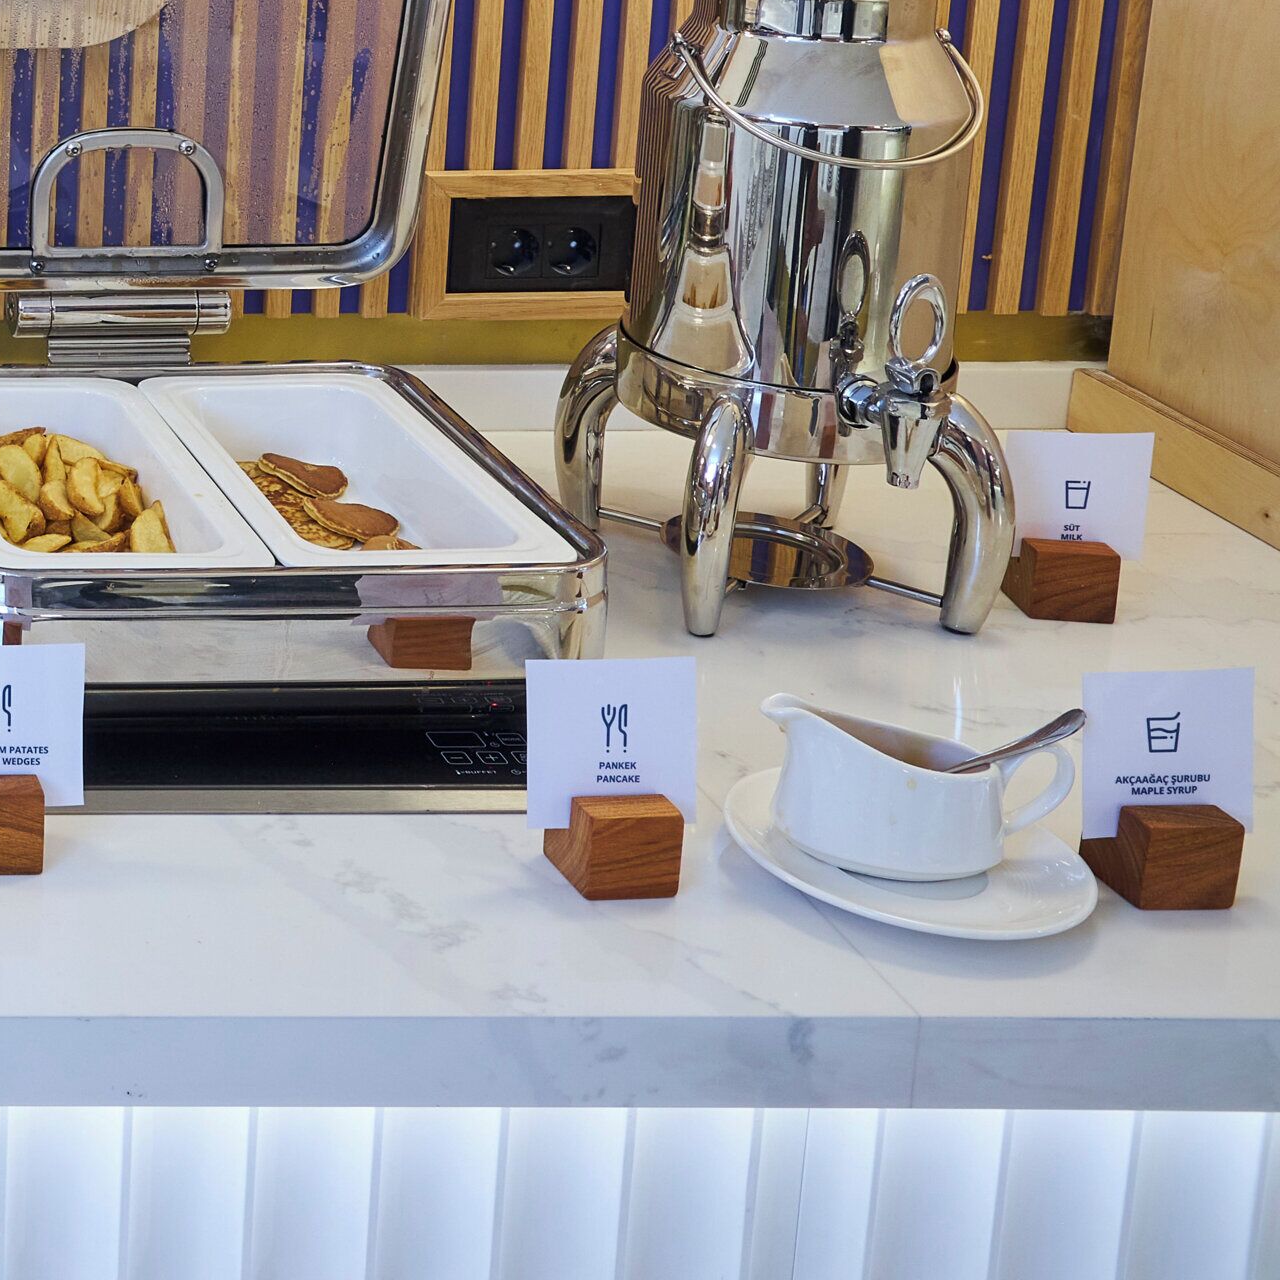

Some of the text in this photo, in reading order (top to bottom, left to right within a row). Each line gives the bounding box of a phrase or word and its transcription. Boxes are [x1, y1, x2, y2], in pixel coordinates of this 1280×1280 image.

[9, 745, 49, 754] PATATES
[2, 757, 41, 766] WEDGES
[599, 762, 637, 770] PANKEK
[596, 775, 640, 783] PANCAKE
[1115, 774, 1210, 785] AKÇAAĞAÇ ŞURUBU
[1132, 786, 1197, 795] MAPLE SYRUP
